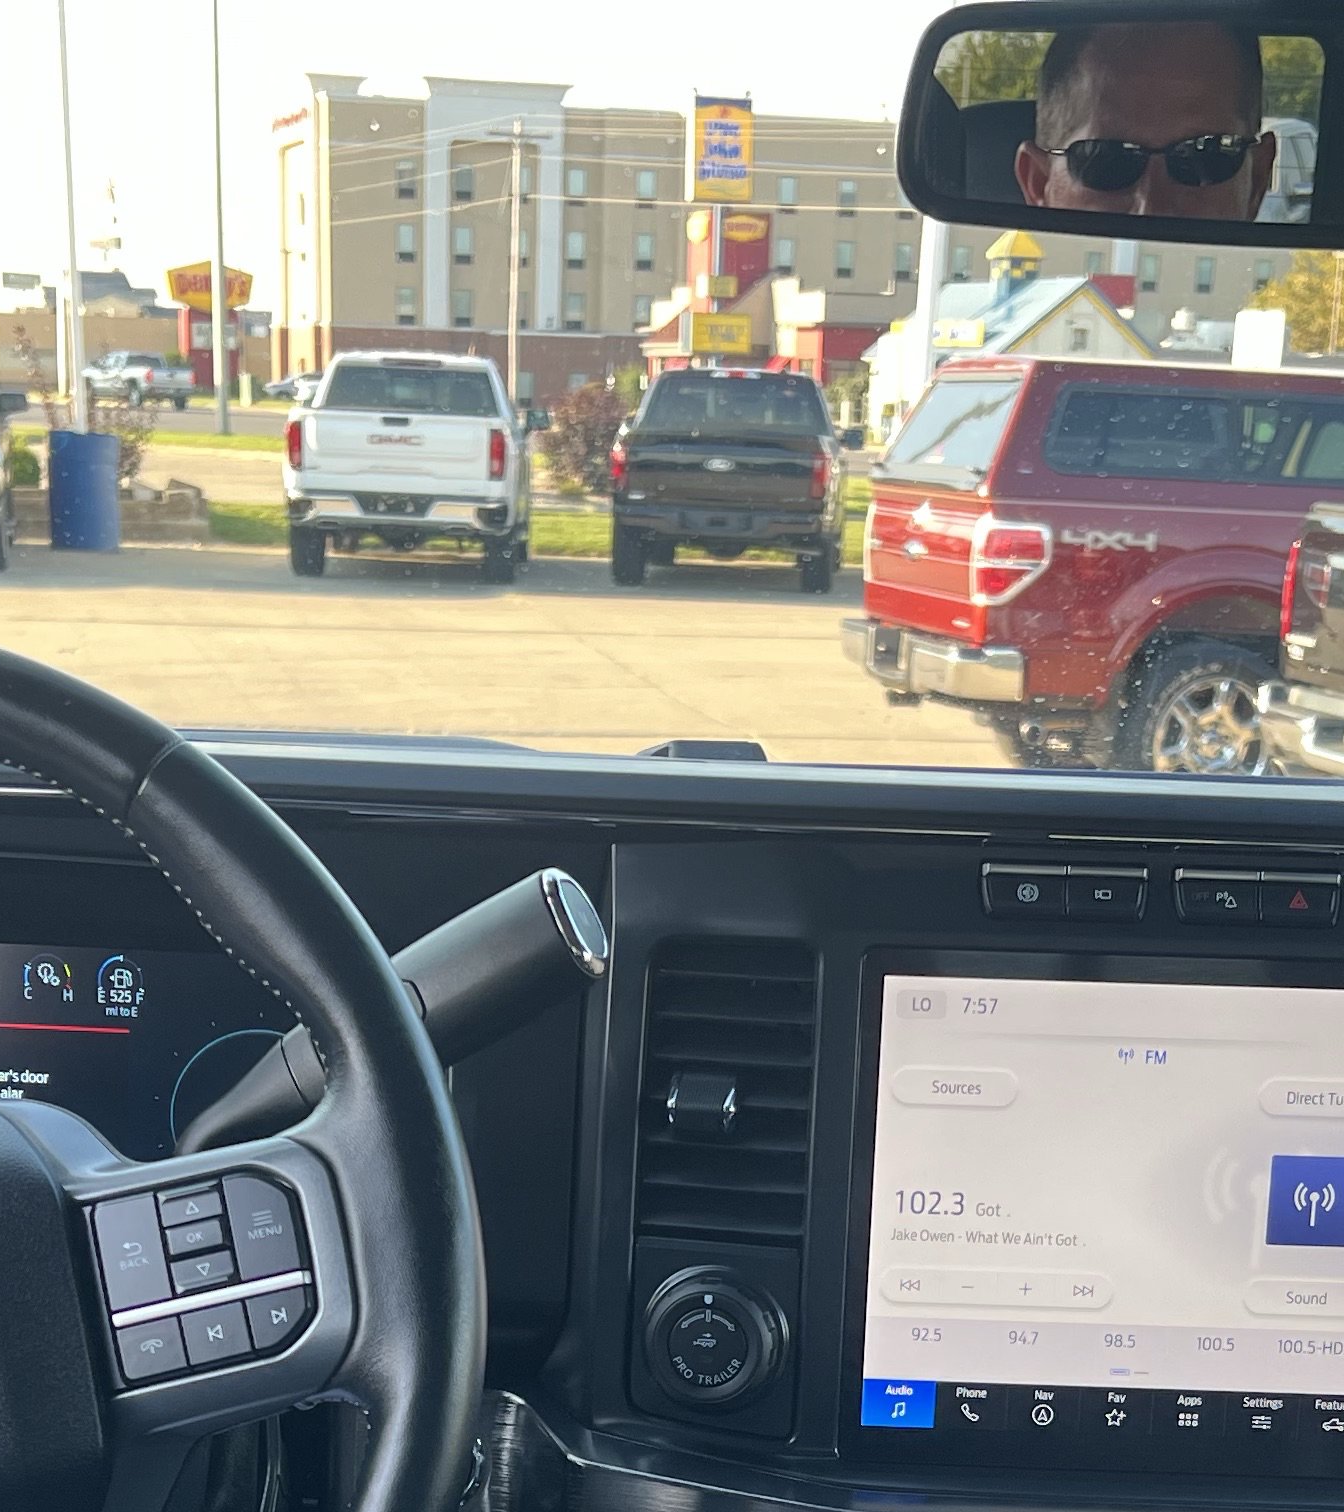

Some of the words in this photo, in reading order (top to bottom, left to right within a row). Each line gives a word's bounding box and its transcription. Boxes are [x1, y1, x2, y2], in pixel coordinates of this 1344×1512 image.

[109, 989, 132, 1004] 525
[912, 997, 932, 1012] LO
[962, 997, 998, 1015] 7:57
[1145, 1050, 1167, 1065] FM
[20, 1069, 50, 1084] door
[931, 1080, 982, 1095] Sources
[1286, 1091, 1325, 1106] Direct
[895, 1190, 965, 1216] 102.3
[975, 1202, 1002, 1217] Got
[186, 1232, 205, 1242] OK
[247, 1225, 283, 1241] MENU
[891, 1228, 918, 1242] Jake
[919, 1229, 955, 1243] Owen
[965, 1231, 999, 1245] What
[1001, 1232, 1022, 1245] We
[1023, 1232, 1053, 1246] Ain't
[1055, 1233, 1078, 1247] Got
[1285, 1291, 1328, 1306] Sound
[911, 1327, 943, 1343] 92.5
[1008, 1330, 1040, 1346] 94.7
[1104, 1333, 1137, 1349] 98.5
[1196, 1337, 1236, 1353] 100.5
[673, 1355, 694, 1379] PRO
[698, 1358, 743, 1386] TRAILER
[885, 1383, 914, 1397] Audio
[956, 1387, 988, 1400] Phone
[1034, 1389, 1055, 1402] Nav
[1108, 1391, 1127, 1405] Fav
[1176, 1394, 1203, 1408] Apps
[1242, 1396, 1284, 1411] Settings
